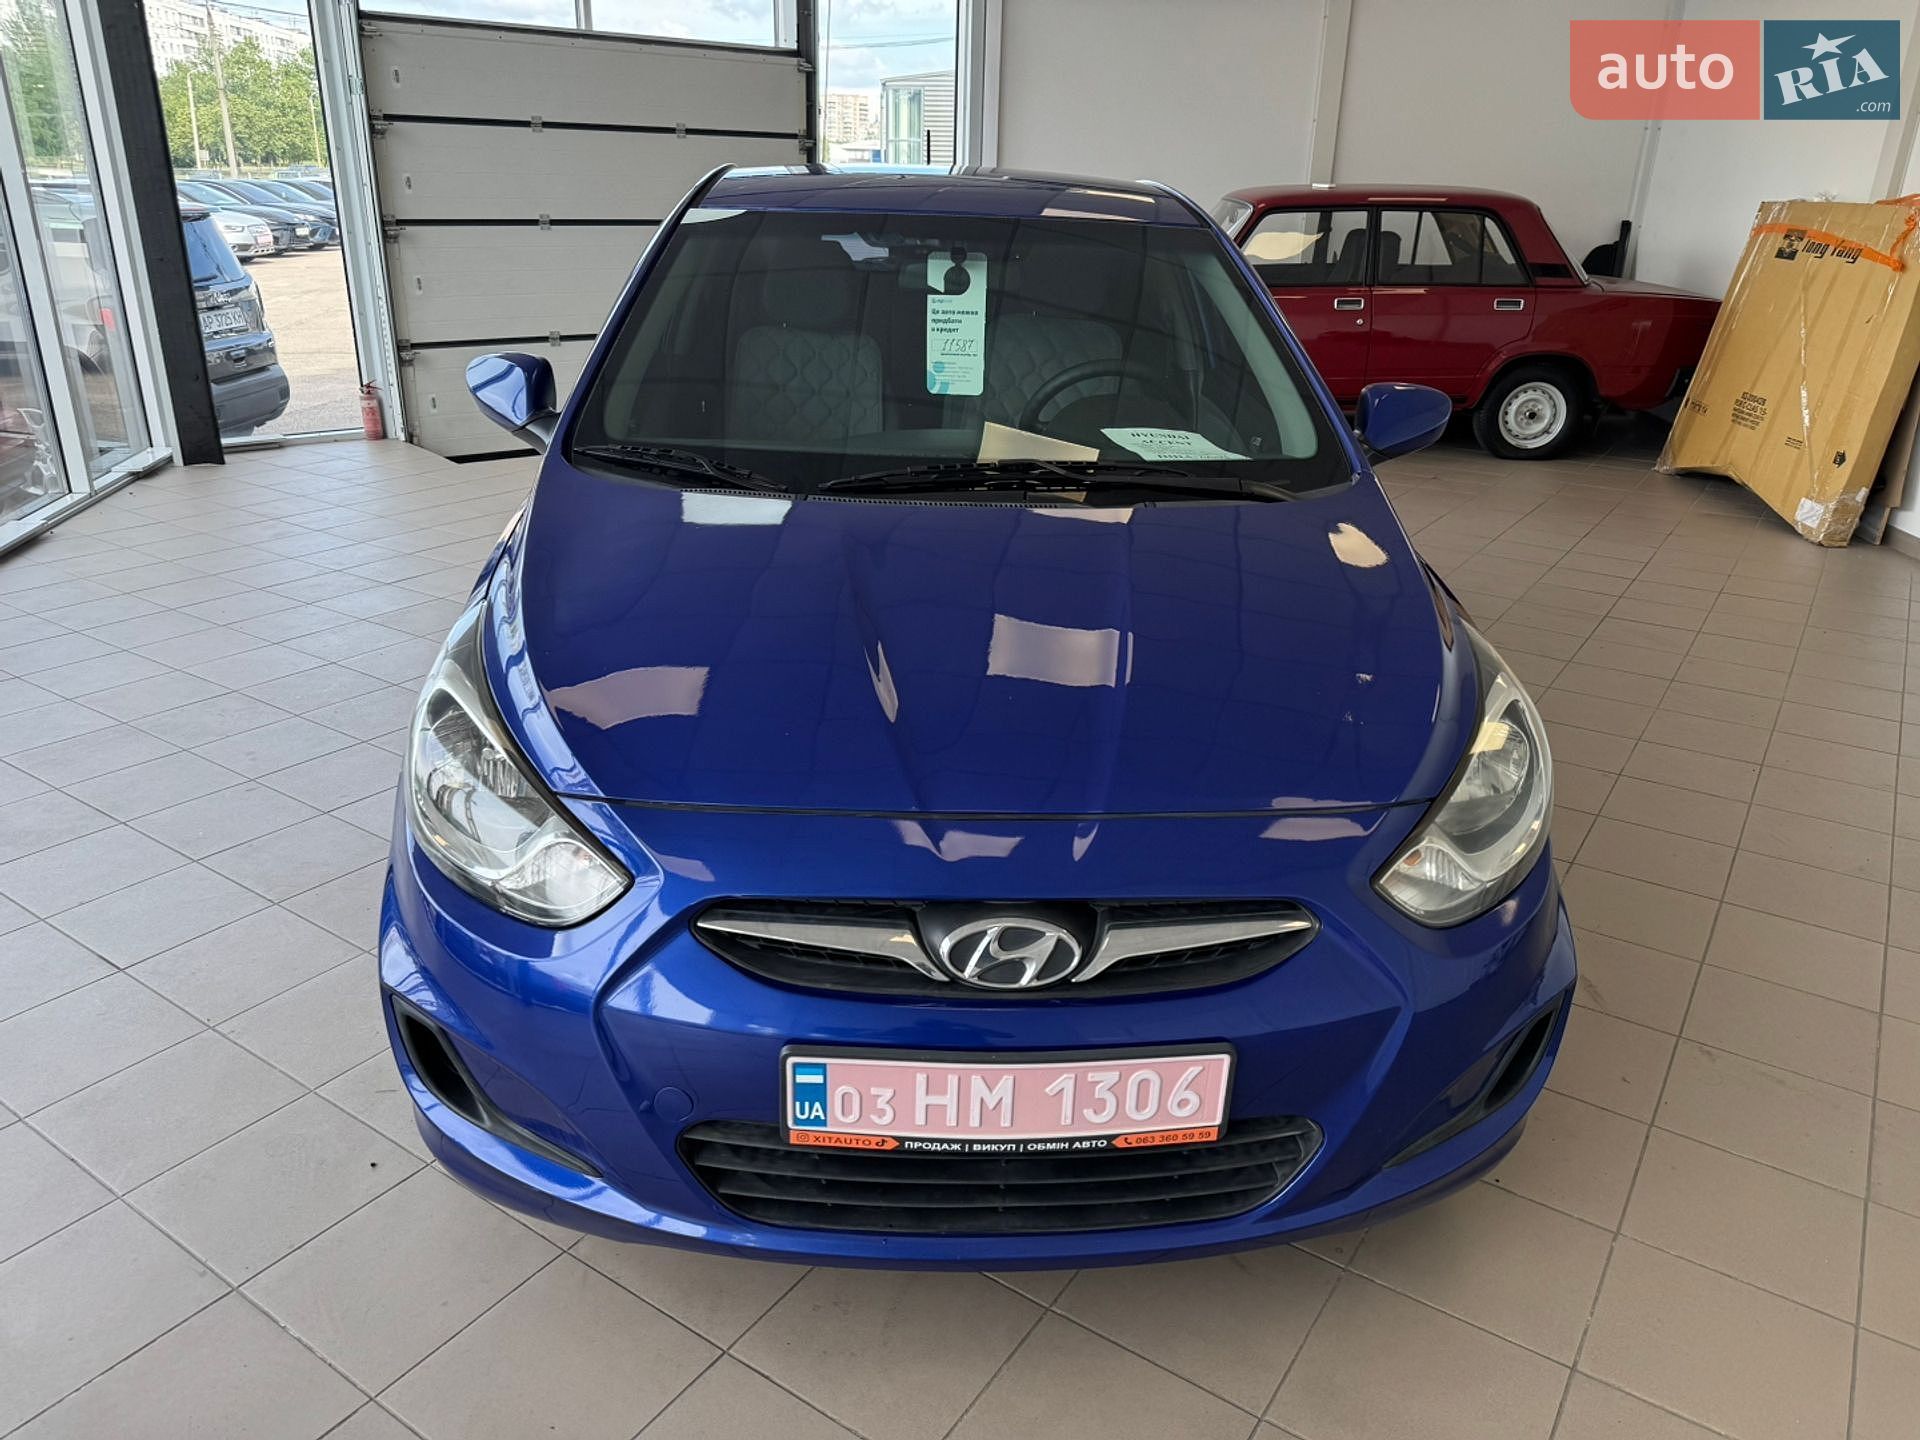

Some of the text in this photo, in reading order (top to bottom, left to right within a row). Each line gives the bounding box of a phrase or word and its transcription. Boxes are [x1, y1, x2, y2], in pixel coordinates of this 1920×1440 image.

[833, 1066, 1206, 1129] 03 HM 1306
[795, 1102, 825, 1120] UA
[812, 1134, 872, 1147] XITAUTO
[1135, 1130, 1211, 1145] 063 360 59 59
[904, 1139, 1108, 1152] ПРОДАЖ ВИКУП ОБМІН АВТО
